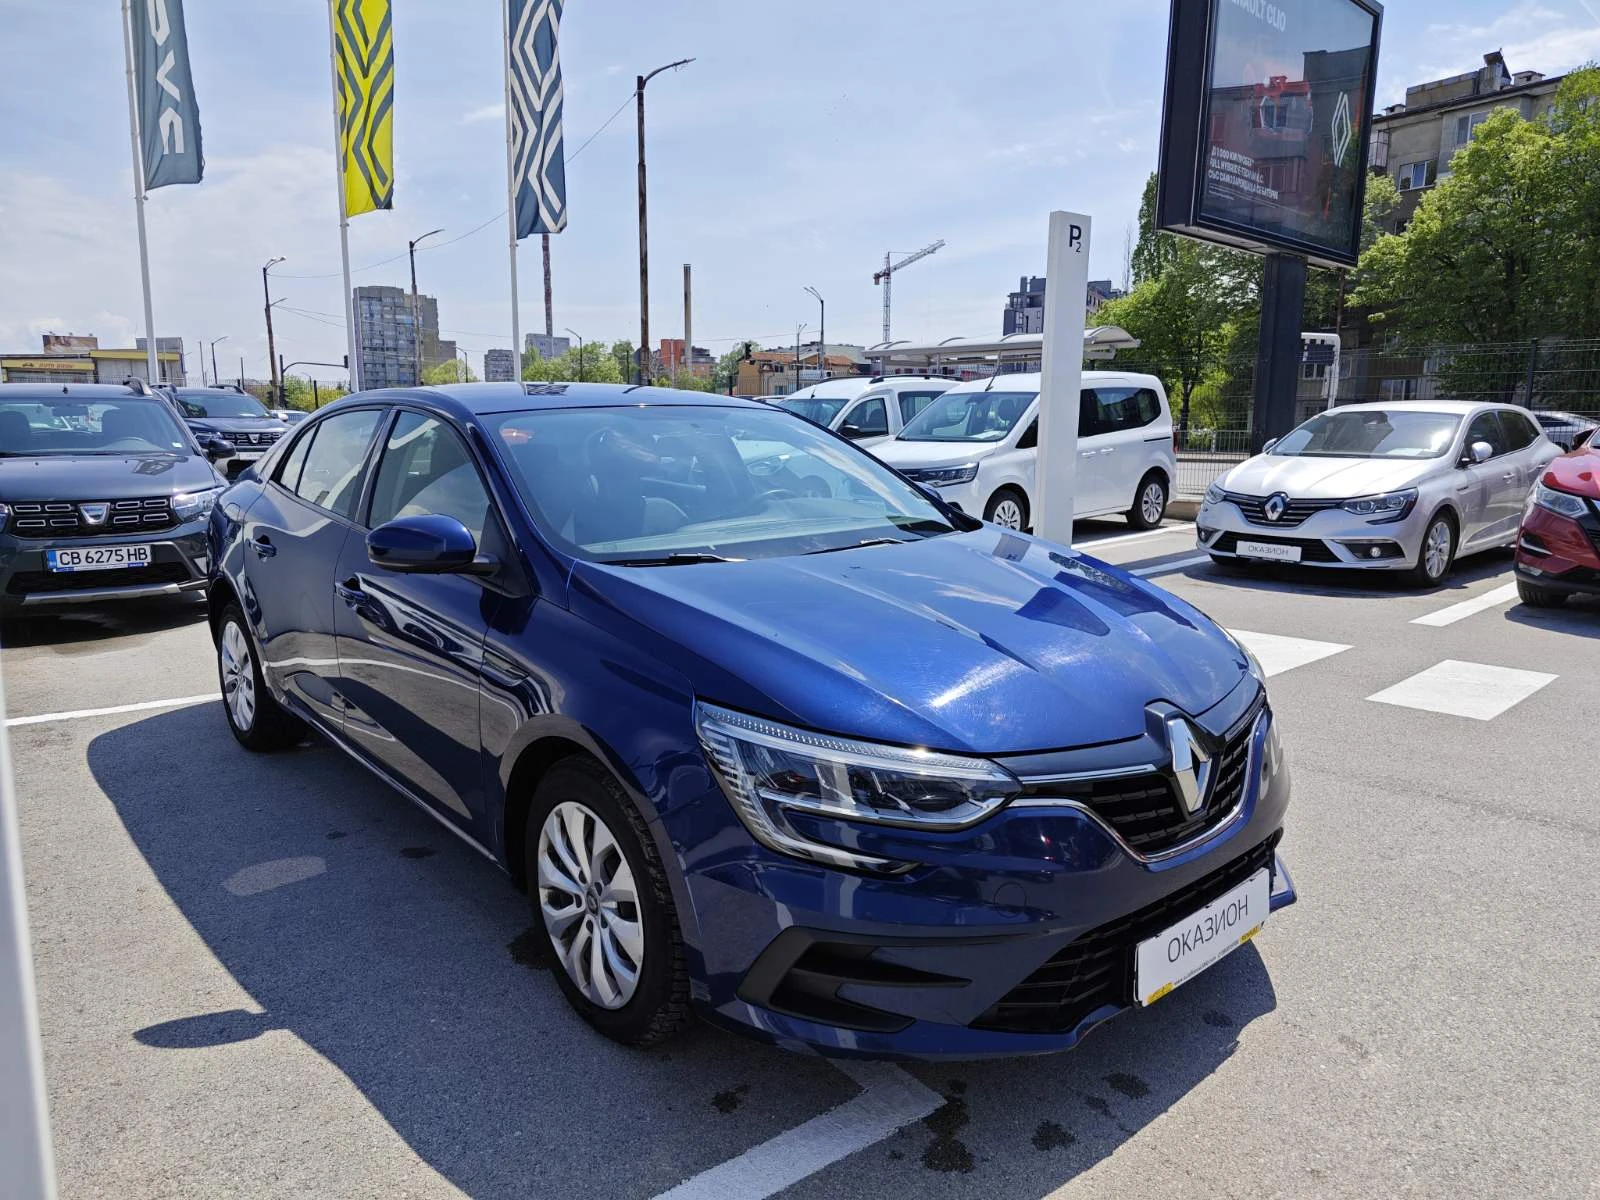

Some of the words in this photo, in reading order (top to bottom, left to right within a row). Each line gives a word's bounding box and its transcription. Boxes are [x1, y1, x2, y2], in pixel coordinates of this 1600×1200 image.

[1267, 3, 1287, 33] CLIO
[60, 552, 81, 566] CB
[85, 549, 124, 564] 6275
[127, 547, 148, 561] HB
[1248, 544, 1289, 556] ОКАЗИОН
[1167, 894, 1248, 963] ОКАЗИОН
